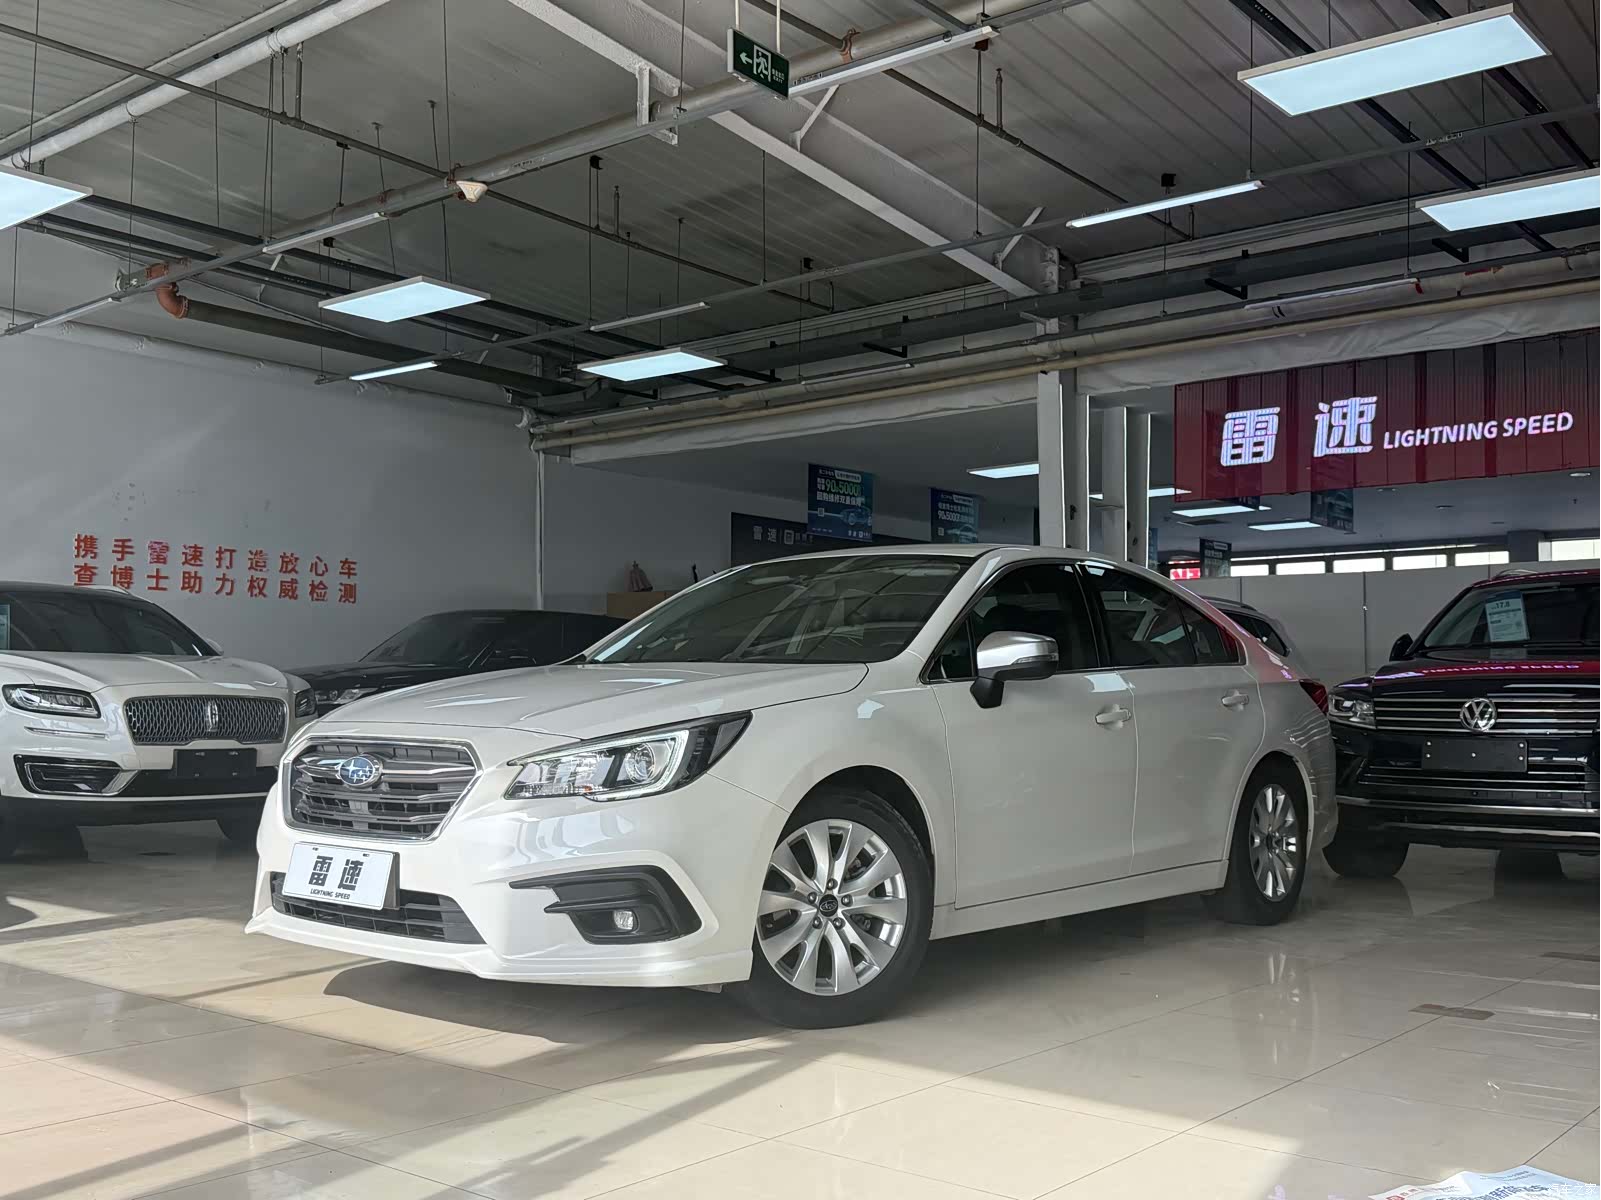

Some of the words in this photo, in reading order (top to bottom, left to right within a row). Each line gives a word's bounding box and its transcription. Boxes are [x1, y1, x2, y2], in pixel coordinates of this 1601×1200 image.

[1220, 396, 1377, 466] 雷速
[1383, 420, 1497, 450] LIGHTNING
[1502, 411, 1574, 438] SPEED
[74, 533, 357, 579] 携手雷速打造放心车
[73, 563, 357, 604] 查博士助力权威检测
[308, 855, 364, 891] 雷速
[310, 888, 334, 898] LIGHTNING
[335, 892, 351, 900] SPEED
